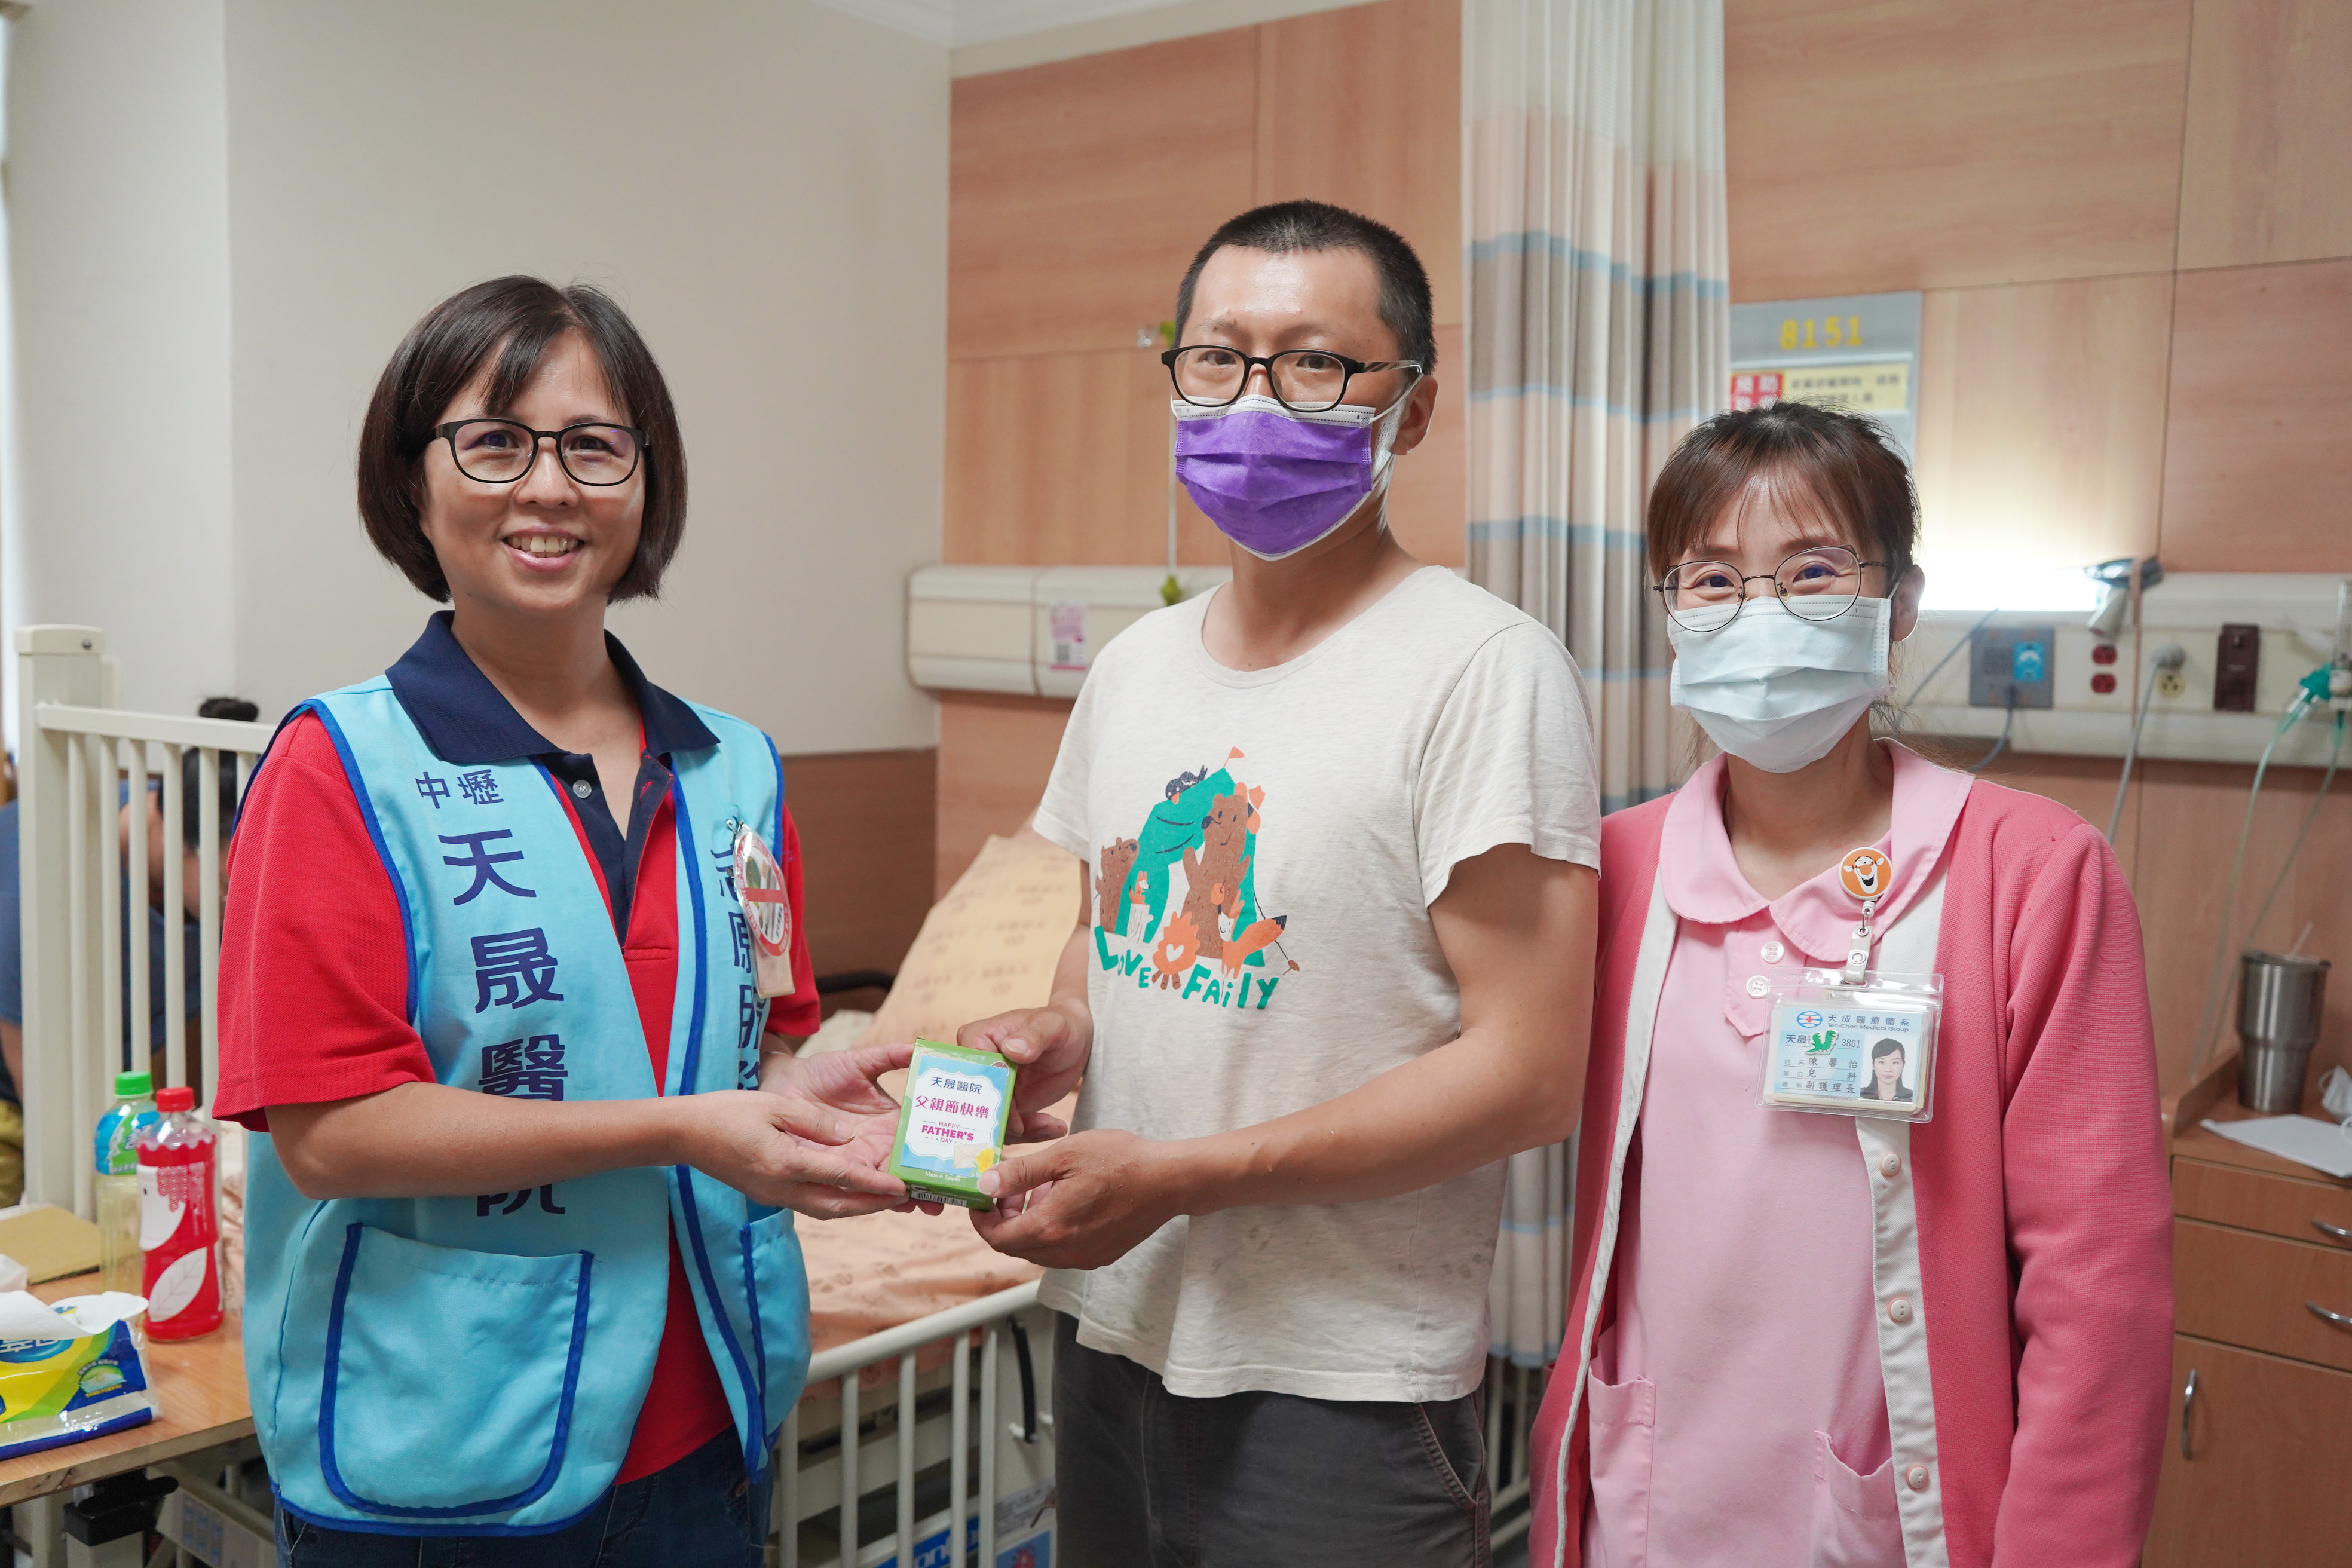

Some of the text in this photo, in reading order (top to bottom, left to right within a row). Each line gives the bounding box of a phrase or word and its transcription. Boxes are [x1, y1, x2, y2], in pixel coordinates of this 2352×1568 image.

[1780, 316, 1863, 350] 8151
[415, 769, 504, 810] 中壢
[1827, 1013, 1910, 1027] 天成醫療體系
[1841, 1039, 1860, 1048] 3861
[1808, 1056, 1858, 1069] 陳馨怡
[1806, 1068, 1857, 1082] 兒科
[930, 1076, 983, 1095] 天晟醫院
[1806, 1080, 1855, 1094] 副護理長
[914, 1095, 990, 1119] 父親節快樂
[938, 1121, 960, 1129] HAPPY
[921, 1125, 975, 1141] FATHER'S
